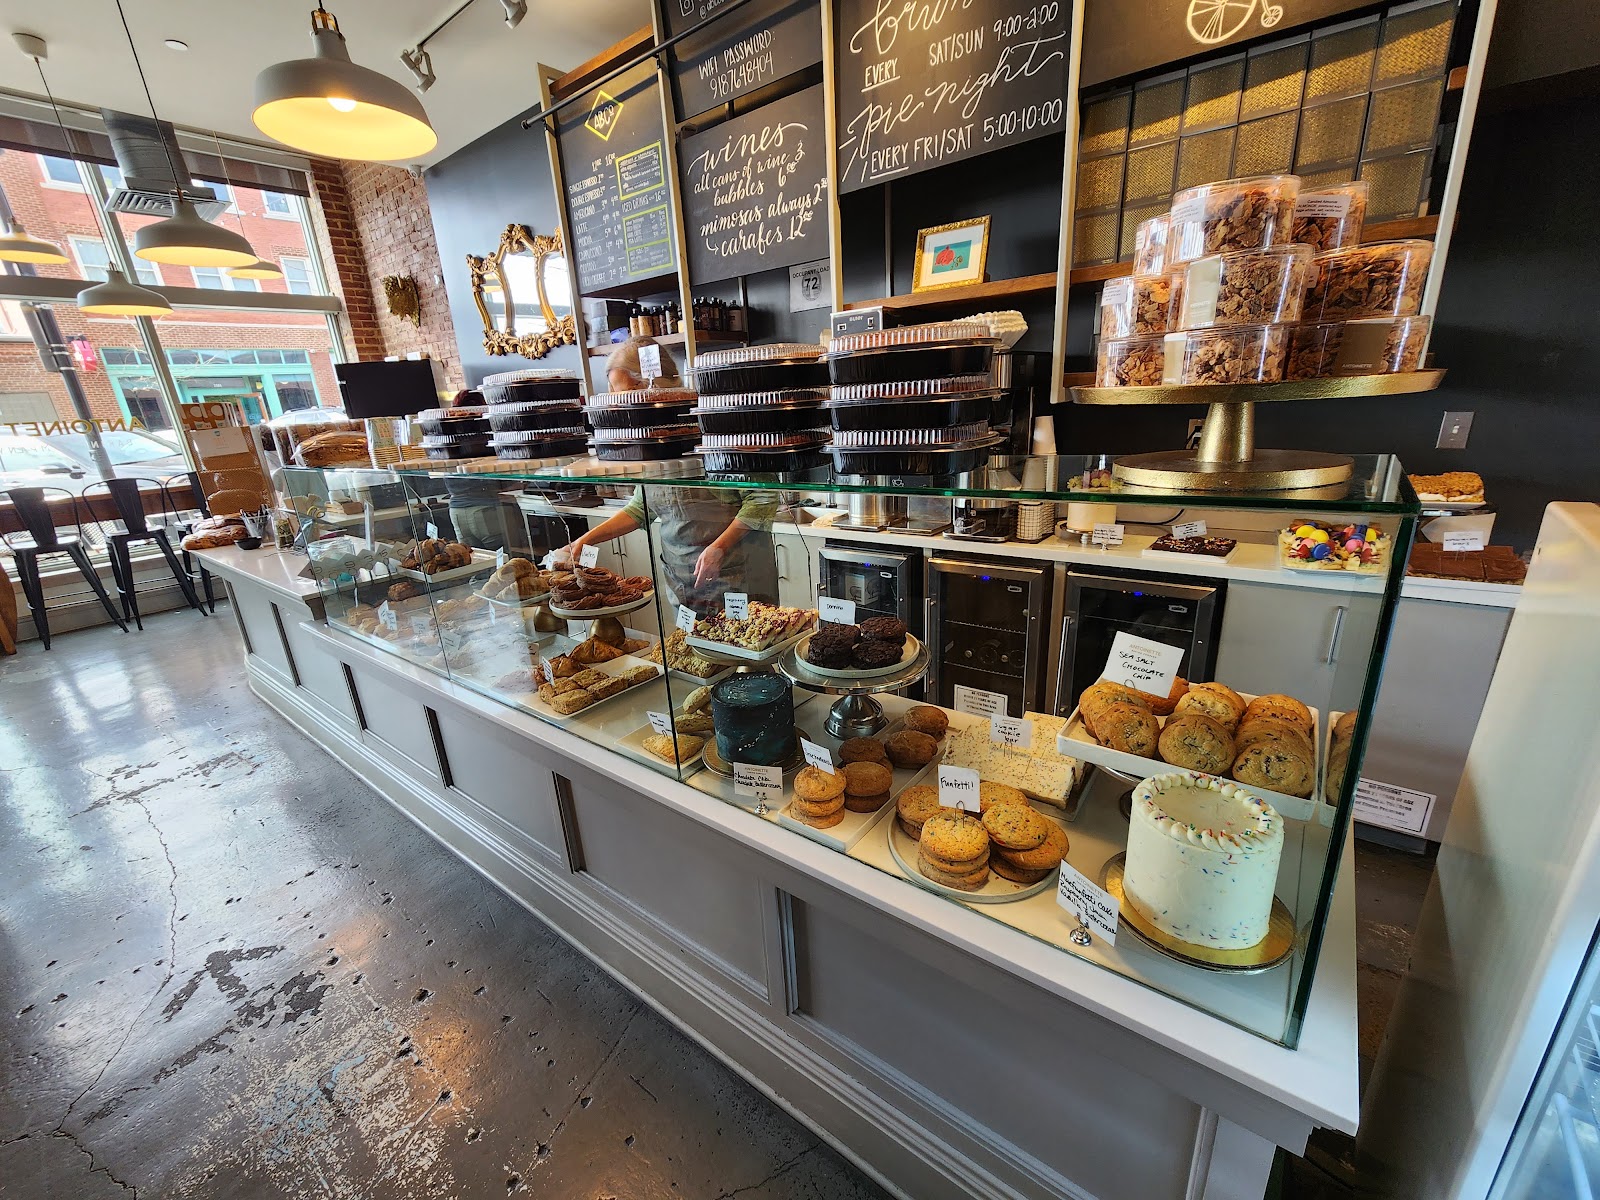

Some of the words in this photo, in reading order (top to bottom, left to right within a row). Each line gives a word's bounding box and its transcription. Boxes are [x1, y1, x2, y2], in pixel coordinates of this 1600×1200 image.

[698, 55, 718, 80] WIFI
[723, 29, 776, 68] PASSWORD:
[864, 58, 899, 90] EVERY
[929, 26, 985, 66] SAT/SUN
[709, 51, 774, 100] 9187648404
[847, 93, 924, 159] pie
[925, 31, 1067, 119] night
[687, 122, 808, 175] wines
[870, 142, 909, 174] EVERY
[914, 123, 975, 162] FRI/SAT
[983, 98, 1063, 143] 5:00-10:00
[694, 172, 711, 194] all
[712, 170, 740, 189] cans
[742, 157, 753, 181] of
[756, 153, 791, 174] wine
[713, 178, 764, 207] bubbles
[700, 205, 764, 237] mimosas
[767, 192, 812, 216] always
[721, 222, 783, 257] carafes
[792, 266, 817, 279] OCCUPANT
[817, 265, 831, 274] LOAD
[804, 277, 819, 291] 72
[1119, 651, 1134, 659] SEA
[1135, 656, 1155, 666] SALT
[1122, 661, 1165, 677] CHOCOLATE
[1129, 644, 1162, 657] ANTOINETTE
[940, 776, 974, 791] Funfetti!
